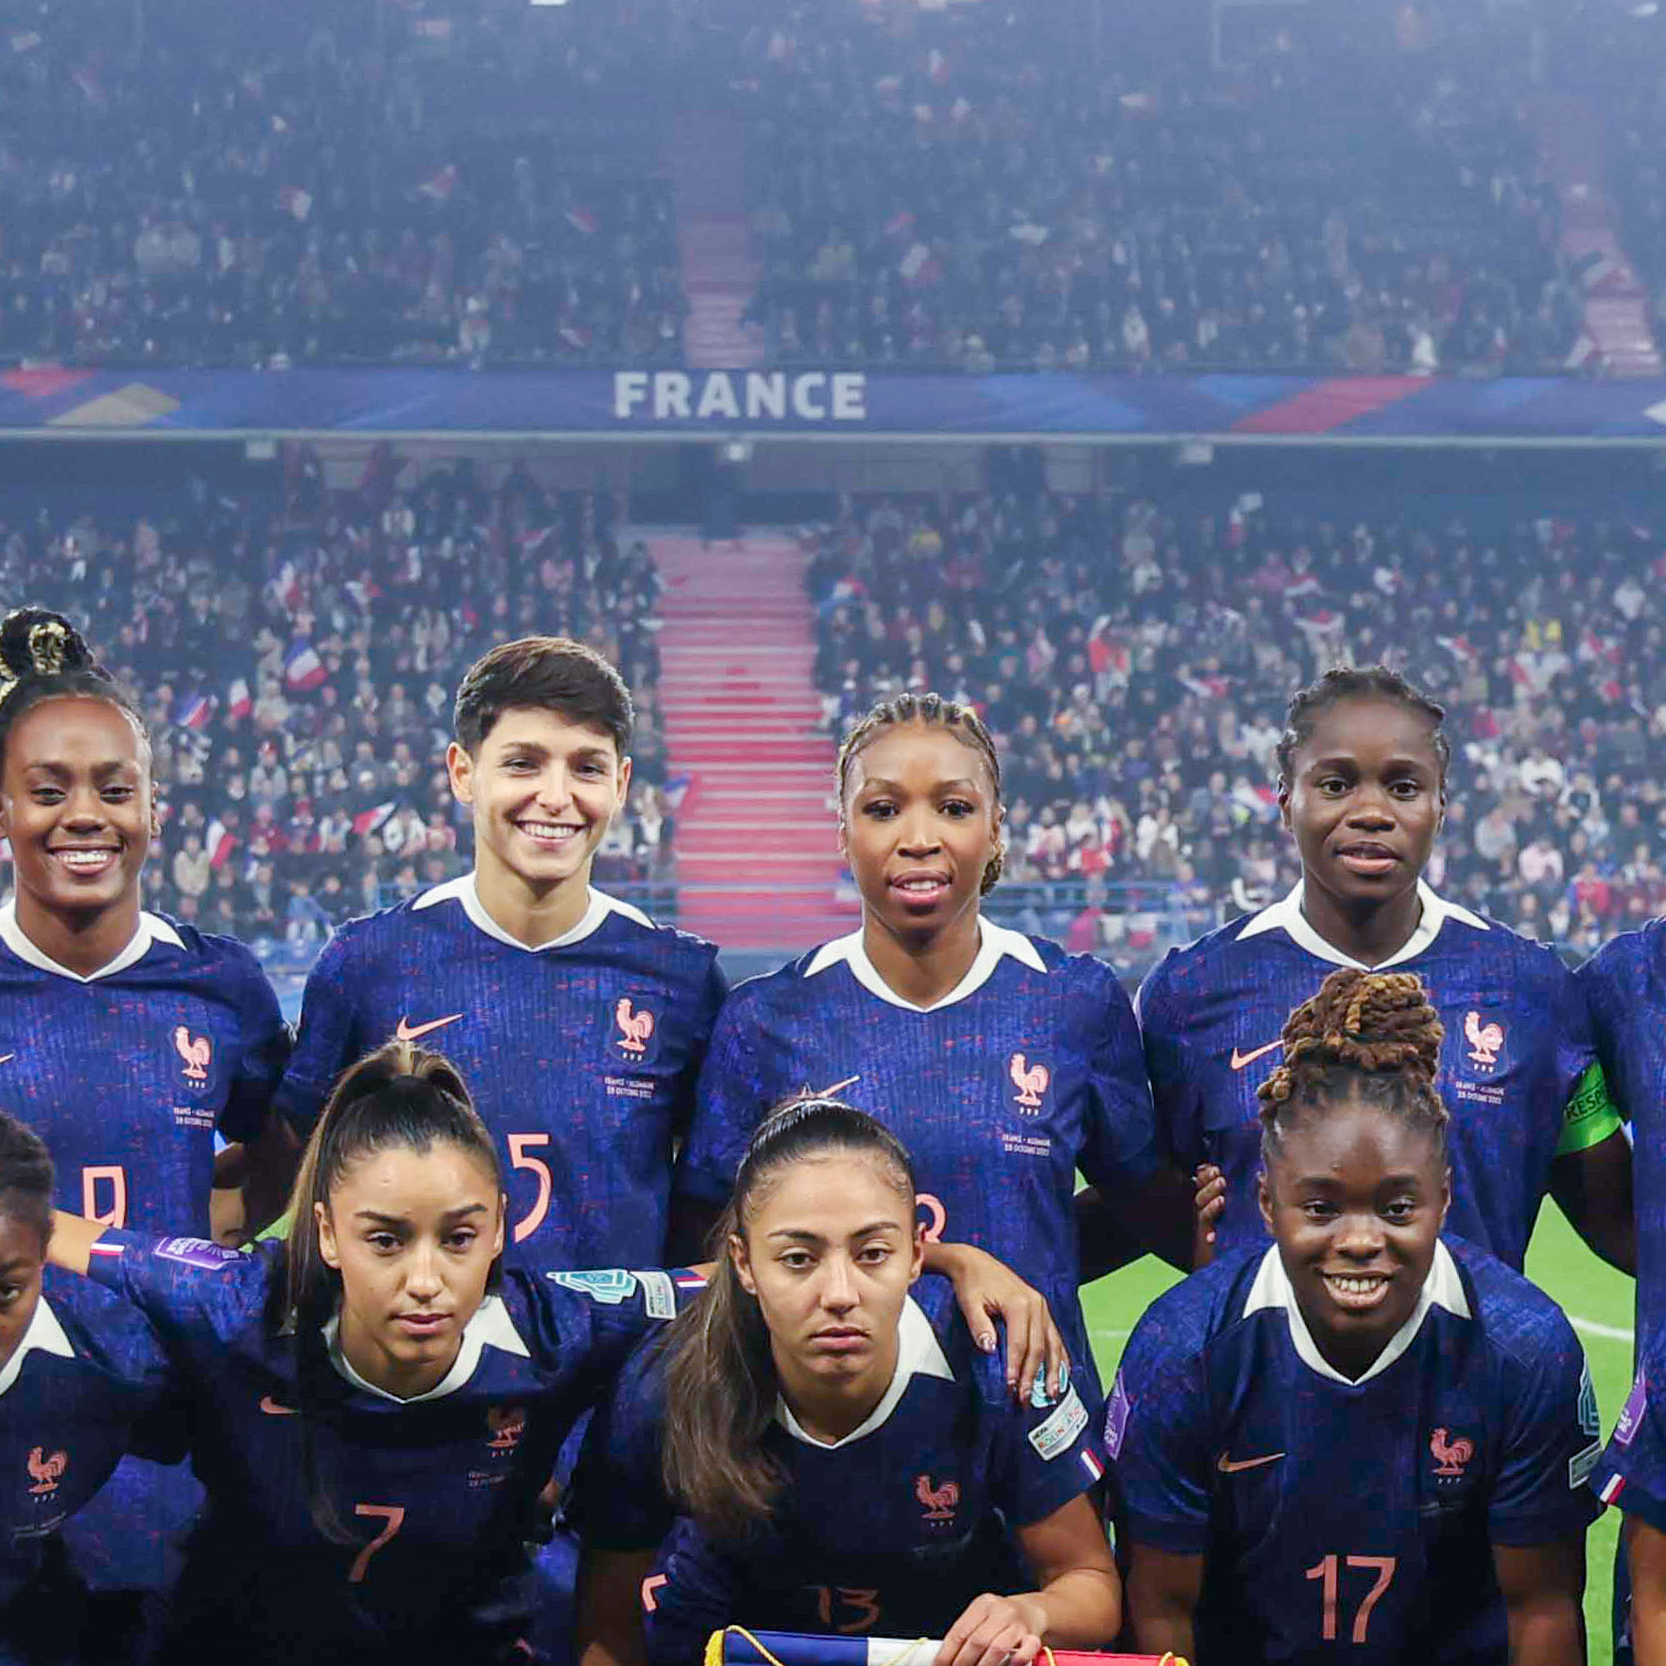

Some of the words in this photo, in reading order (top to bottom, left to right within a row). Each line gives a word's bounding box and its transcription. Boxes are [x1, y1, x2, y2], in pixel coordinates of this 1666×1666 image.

[614, 371, 867, 419] FRANCE
[507, 1133, 552, 1243] 5
[349, 1503, 406, 1583] 7
[816, 1585, 880, 1634] 13
[1306, 1554, 1396, 1643] 17
